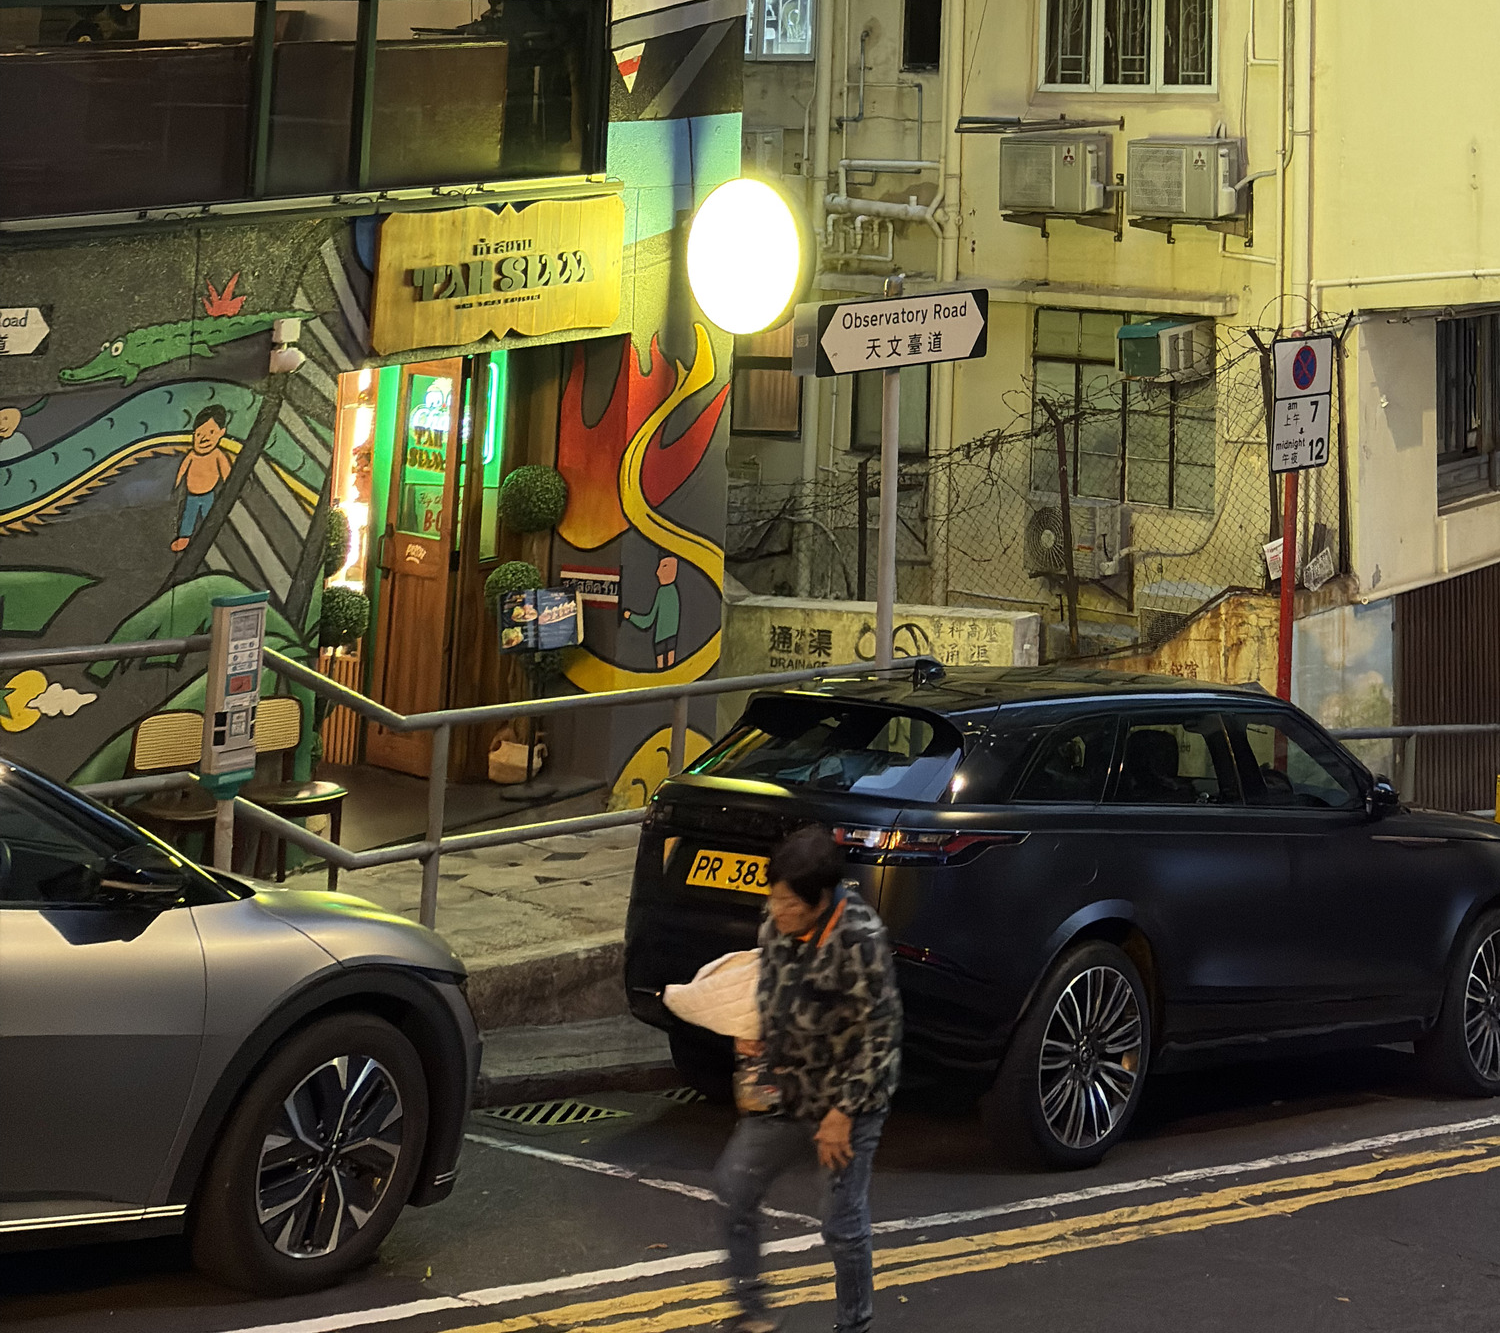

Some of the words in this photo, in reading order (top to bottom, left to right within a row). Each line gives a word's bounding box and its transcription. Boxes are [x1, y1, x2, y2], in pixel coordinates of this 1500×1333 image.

[406, 259, 493, 302] TAH
[0, 308, 29, 328] oad
[842, 307, 929, 330] Observatory
[933, 301, 967, 320] Road
[865, 330, 943, 360] 天文臺道
[1284, 413, 1300, 427] 上午
[1287, 401, 1298, 411] am
[1310, 400, 1319, 423] 7
[1276, 438, 1305, 451] midnight
[1308, 437, 1325, 461] 12
[1282, 452, 1298, 466] 午夜
[692, 855, 724, 882] PR
